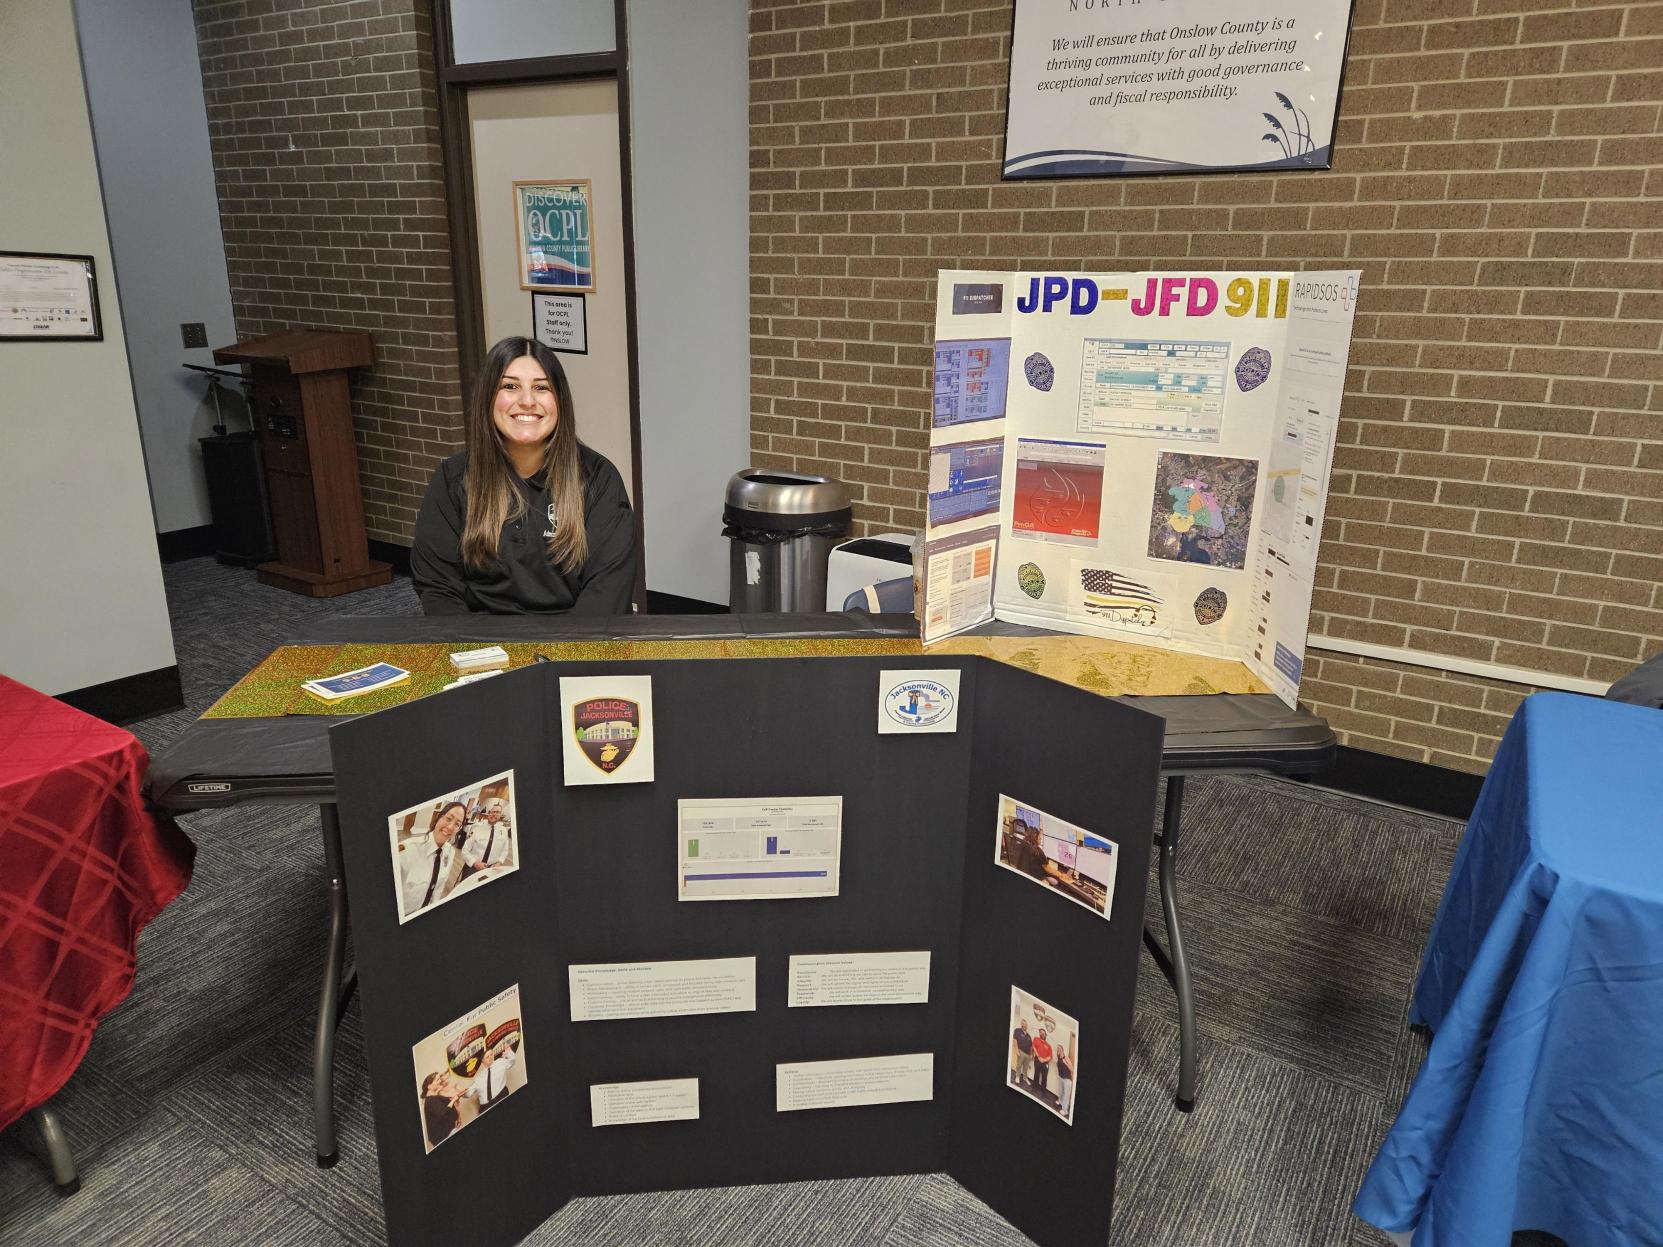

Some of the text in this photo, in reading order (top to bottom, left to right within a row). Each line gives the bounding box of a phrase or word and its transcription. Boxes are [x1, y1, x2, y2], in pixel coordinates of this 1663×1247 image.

[1052, 17, 1295, 52] We will ensure that Onslow County is a
[1046, 38, 1297, 72] thriving community for all by delivering
[1037, 59, 1303, 92] exceptional services with good governance
[1089, 84, 1238, 107] and fiscal responsibility.
[526, 191, 587, 206] DISCOVER
[1224, 278, 1290, 318] 911
[1295, 282, 1338, 301] RAPIDSOS
[890, 683, 950, 700] Jacksonville NC
[581, 711, 632, 719] JACKSONVILLE
[586, 702, 627, 711] POLICE
